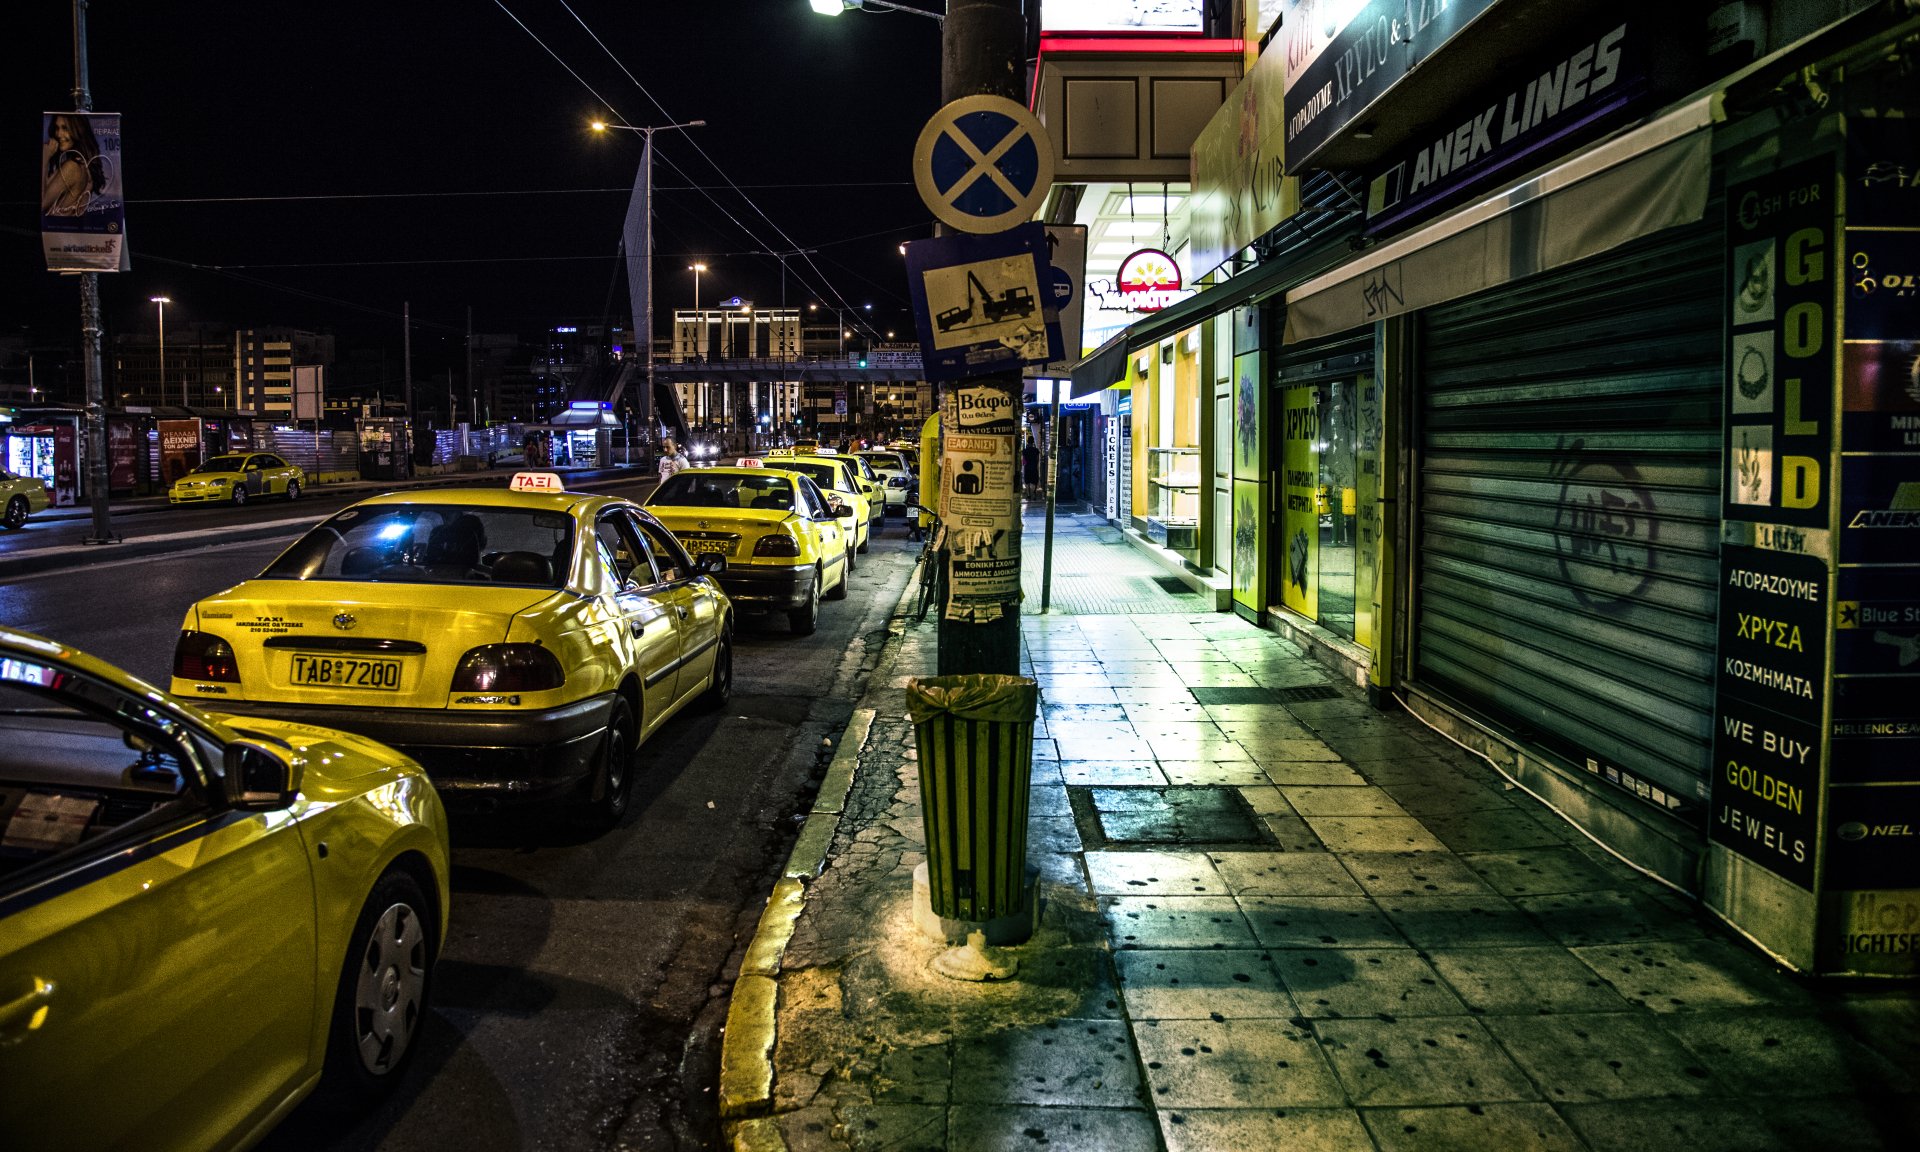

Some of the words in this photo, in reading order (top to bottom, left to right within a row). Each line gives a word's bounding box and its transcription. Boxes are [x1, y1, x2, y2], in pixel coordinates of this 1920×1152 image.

[1289, 81, 1333, 143] ΑΓΟΡΑΖΟΥΜΕ
[1334, 15, 1389, 107] ΧΡΥΣΟ
[1390, 19, 1400, 45] &
[1410, 103, 1498, 195] ANEK
[1500, 22, 1628, 144] LINES
[1251, 149, 1284, 213] CLUB
[1788, 183, 1820, 208] FOR
[1780, 226, 1826, 510] GOLD
[960, 394, 1013, 412] Βάφω
[163, 436, 197, 444] ΔΕΙΧΝΕΙ
[1287, 408, 1316, 440] ΧΡΥΣΟ
[1108, 420, 1116, 477] TICKETS
[517, 477, 551, 487] ΤΑΞΙ
[1729, 568, 1818, 602] ΑΓΟΡΑΖΟΥΜΕ
[1737, 612, 1804, 653] ΧΡΥΣΑ
[1862, 608, 1898, 622] Blue
[344, 661, 398, 687] 7200
[1725, 656, 1814, 700] ΚΟΣΜΗΜΑΤΑ
[1723, 715, 1754, 745] WE
[1763, 730, 1811, 765] BUY
[1833, 723, 1894, 735] HELLENIC
[1726, 760, 1802, 815] GOLDEN
[1719, 804, 1805, 864] JEWELS
[1872, 824, 1913, 836] NEL
